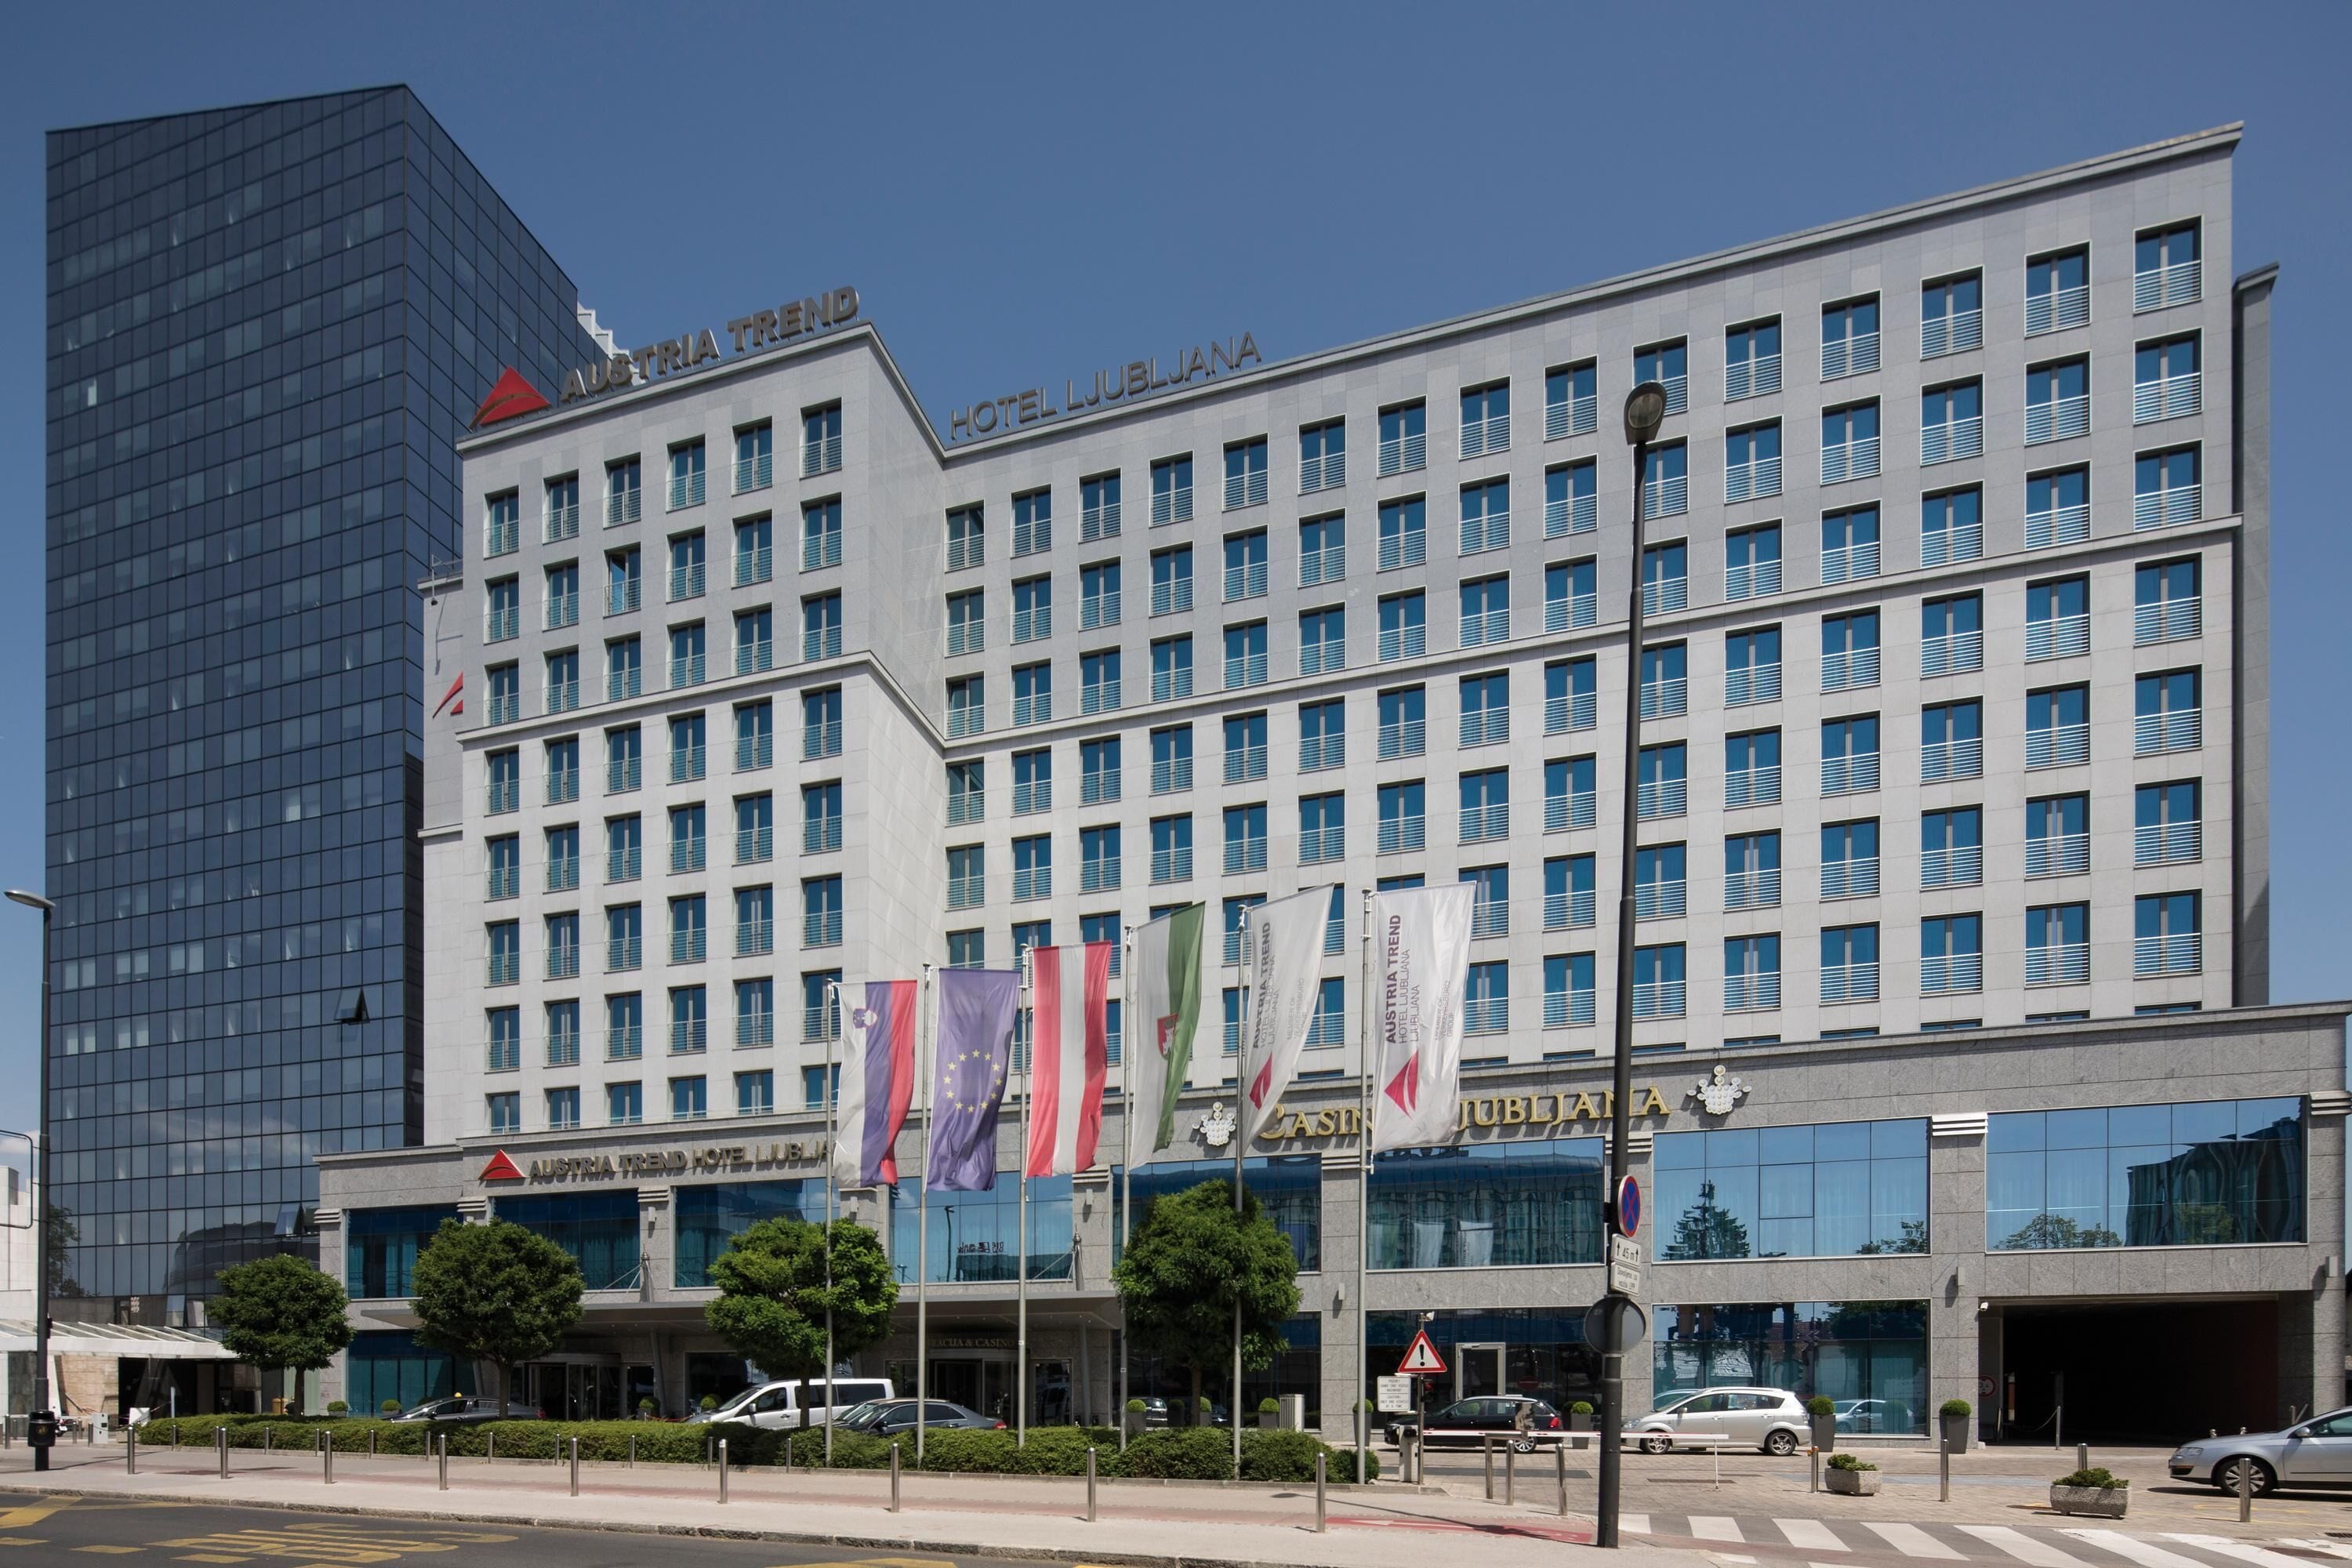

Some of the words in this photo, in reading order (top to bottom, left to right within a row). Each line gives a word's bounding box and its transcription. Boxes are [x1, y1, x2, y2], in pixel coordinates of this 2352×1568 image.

[560, 328, 720, 402] AUSTRIA
[728, 285, 859, 352] TREND
[950, 387, 1058, 441] HOTEL
[1066, 331, 1262, 412] LJUBLJANA
[1388, 914, 1402, 968] TREND
[1254, 979, 1268, 1049] AUSTRIA
[1261, 921, 1271, 978] TREND
[1399, 949, 1410, 1006] LJUBLJANA
[1385, 971, 1399, 1044] AUSTRIA
[1399, 1007, 1408, 1044] HOTEL
[1410, 985, 1420, 1042] LJUBLJANA
[1259, 1102, 1374, 1140] CASIN
[1459, 1085, 1671, 1131] JUBLJANA
[529, 1155, 615, 1176] AUSTRIA
[619, 1150, 688, 1170] TREND
[692, 1146, 753, 1166] HOTEL
[756, 1141, 831, 1162] LJUBLJA
[1622, 1247, 1629, 1260] 45
[975, 1338, 1014, 1347] CASINO
